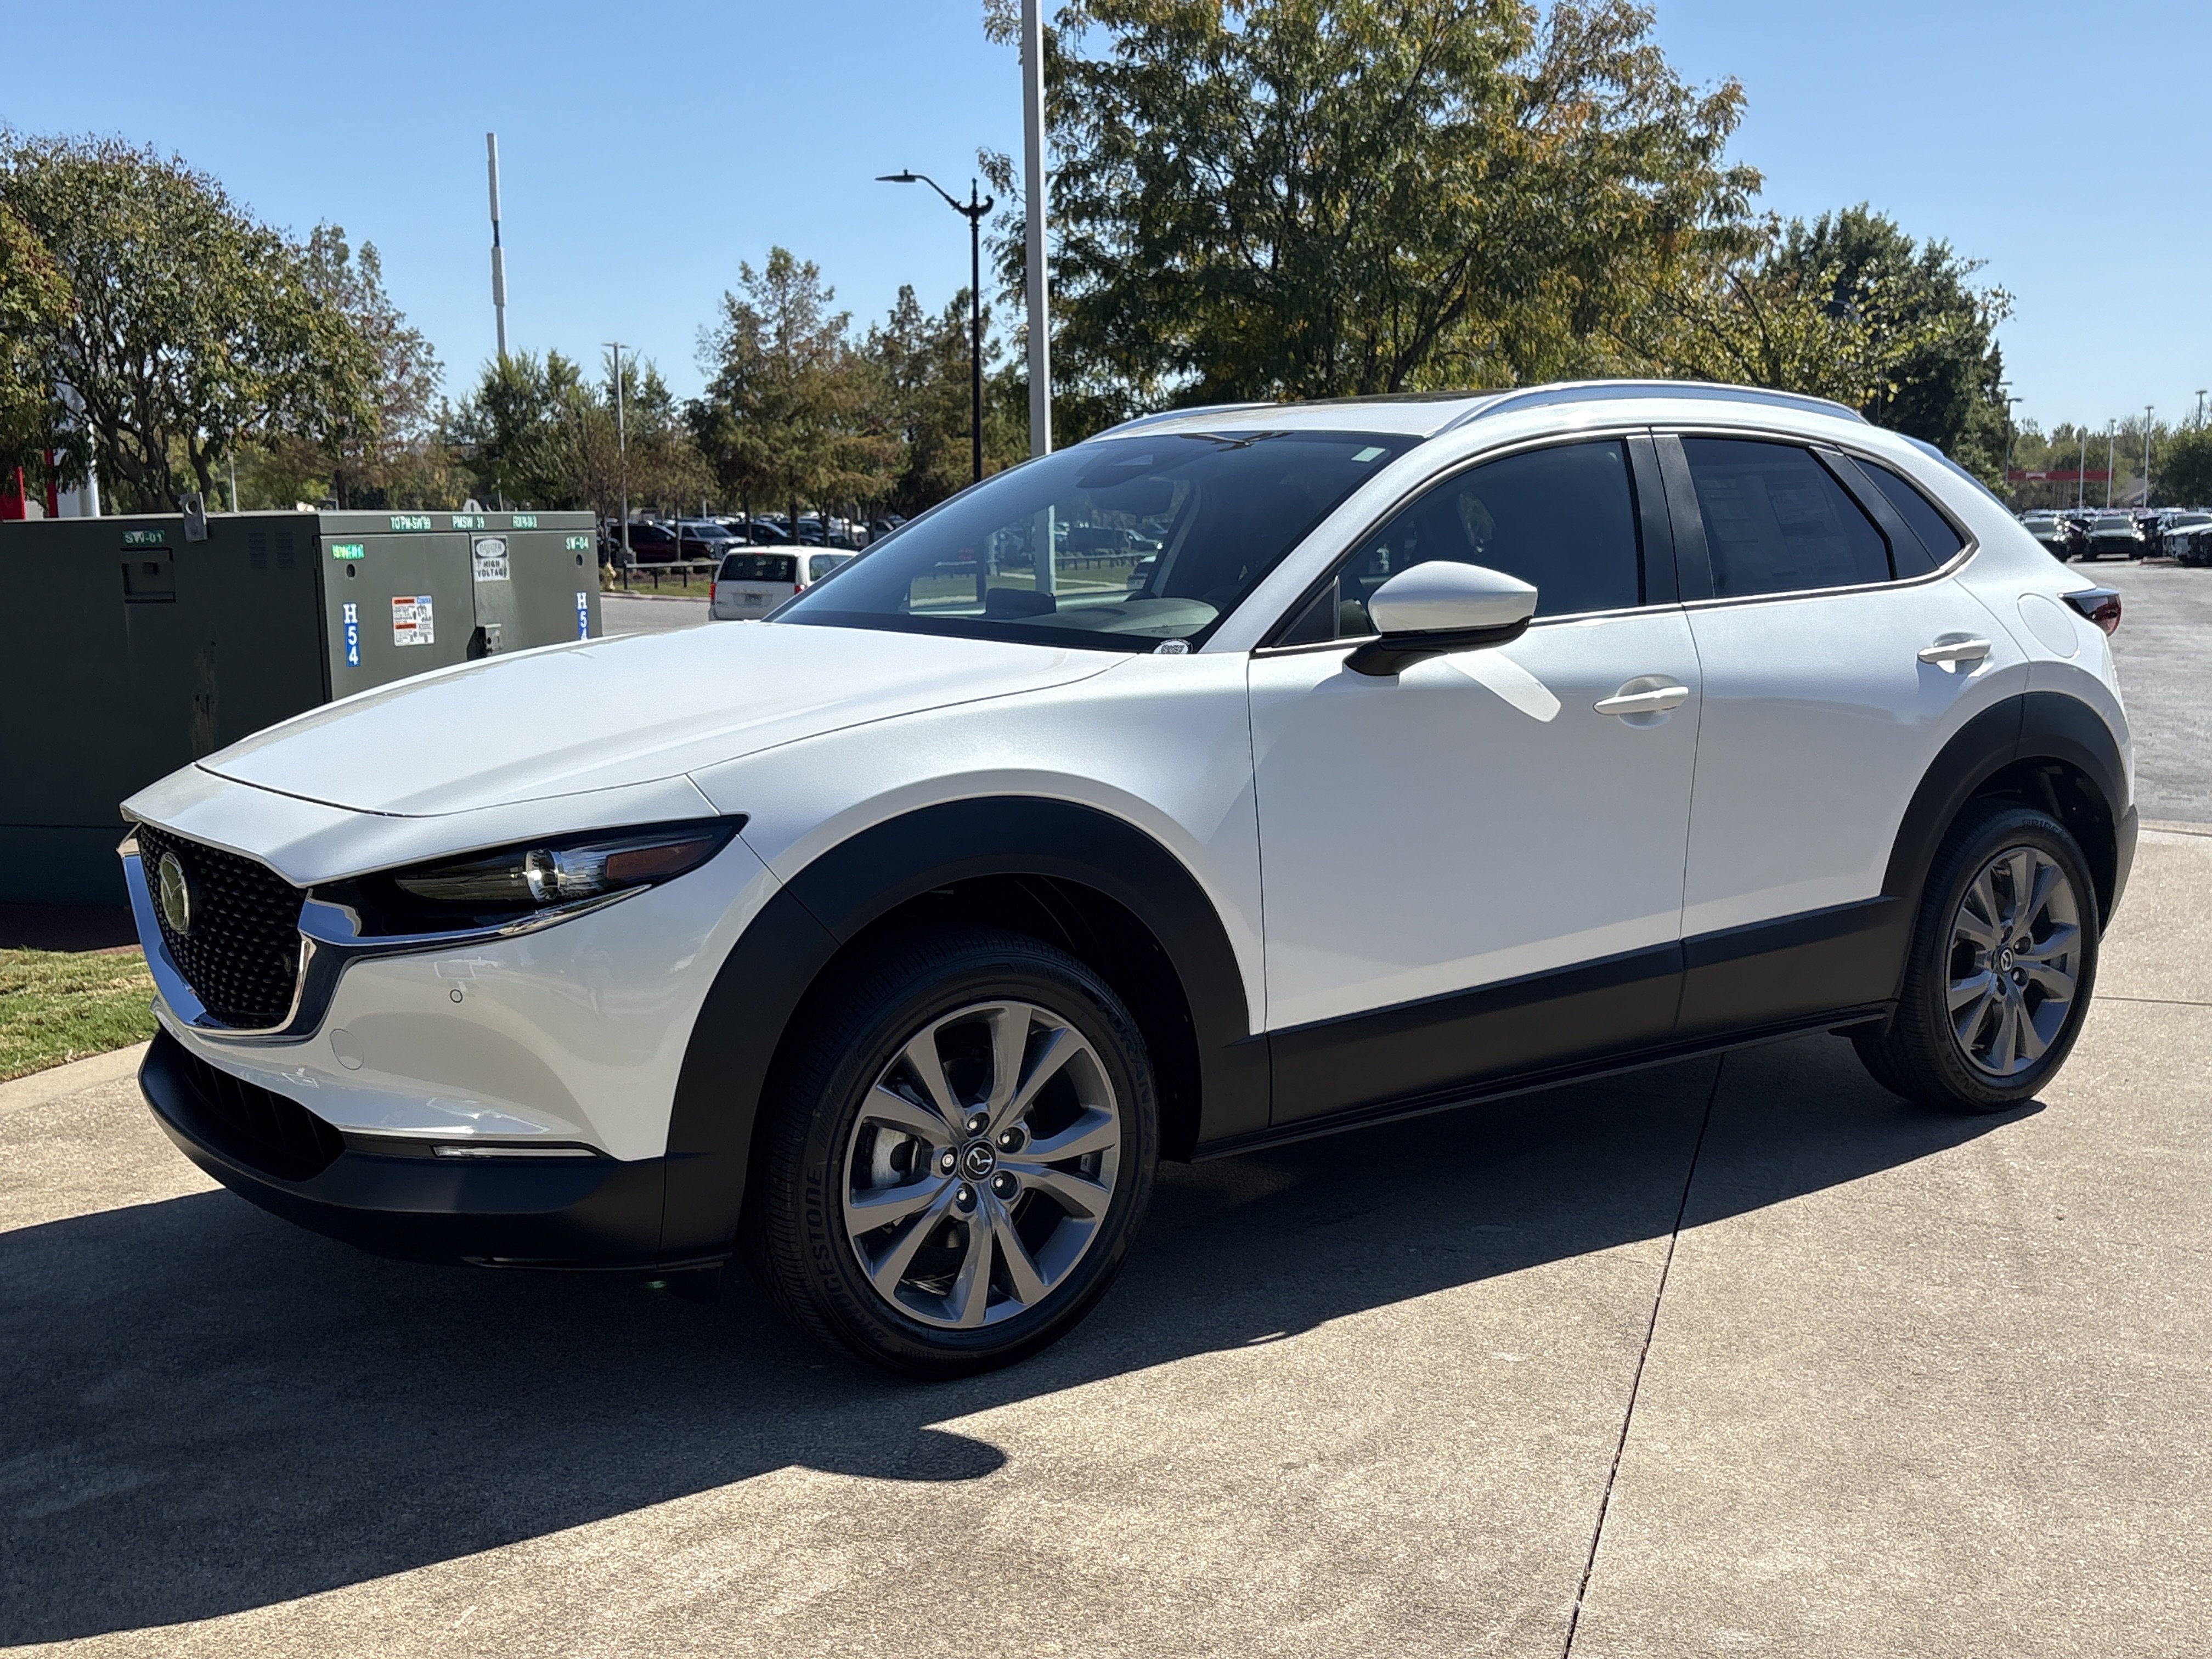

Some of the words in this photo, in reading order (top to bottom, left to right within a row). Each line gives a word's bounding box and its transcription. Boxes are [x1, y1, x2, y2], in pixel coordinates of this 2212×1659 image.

[125, 532, 162, 544] SW-01
[566, 536, 589, 550] SW-04
[477, 567, 507, 578] VOLTAGE
